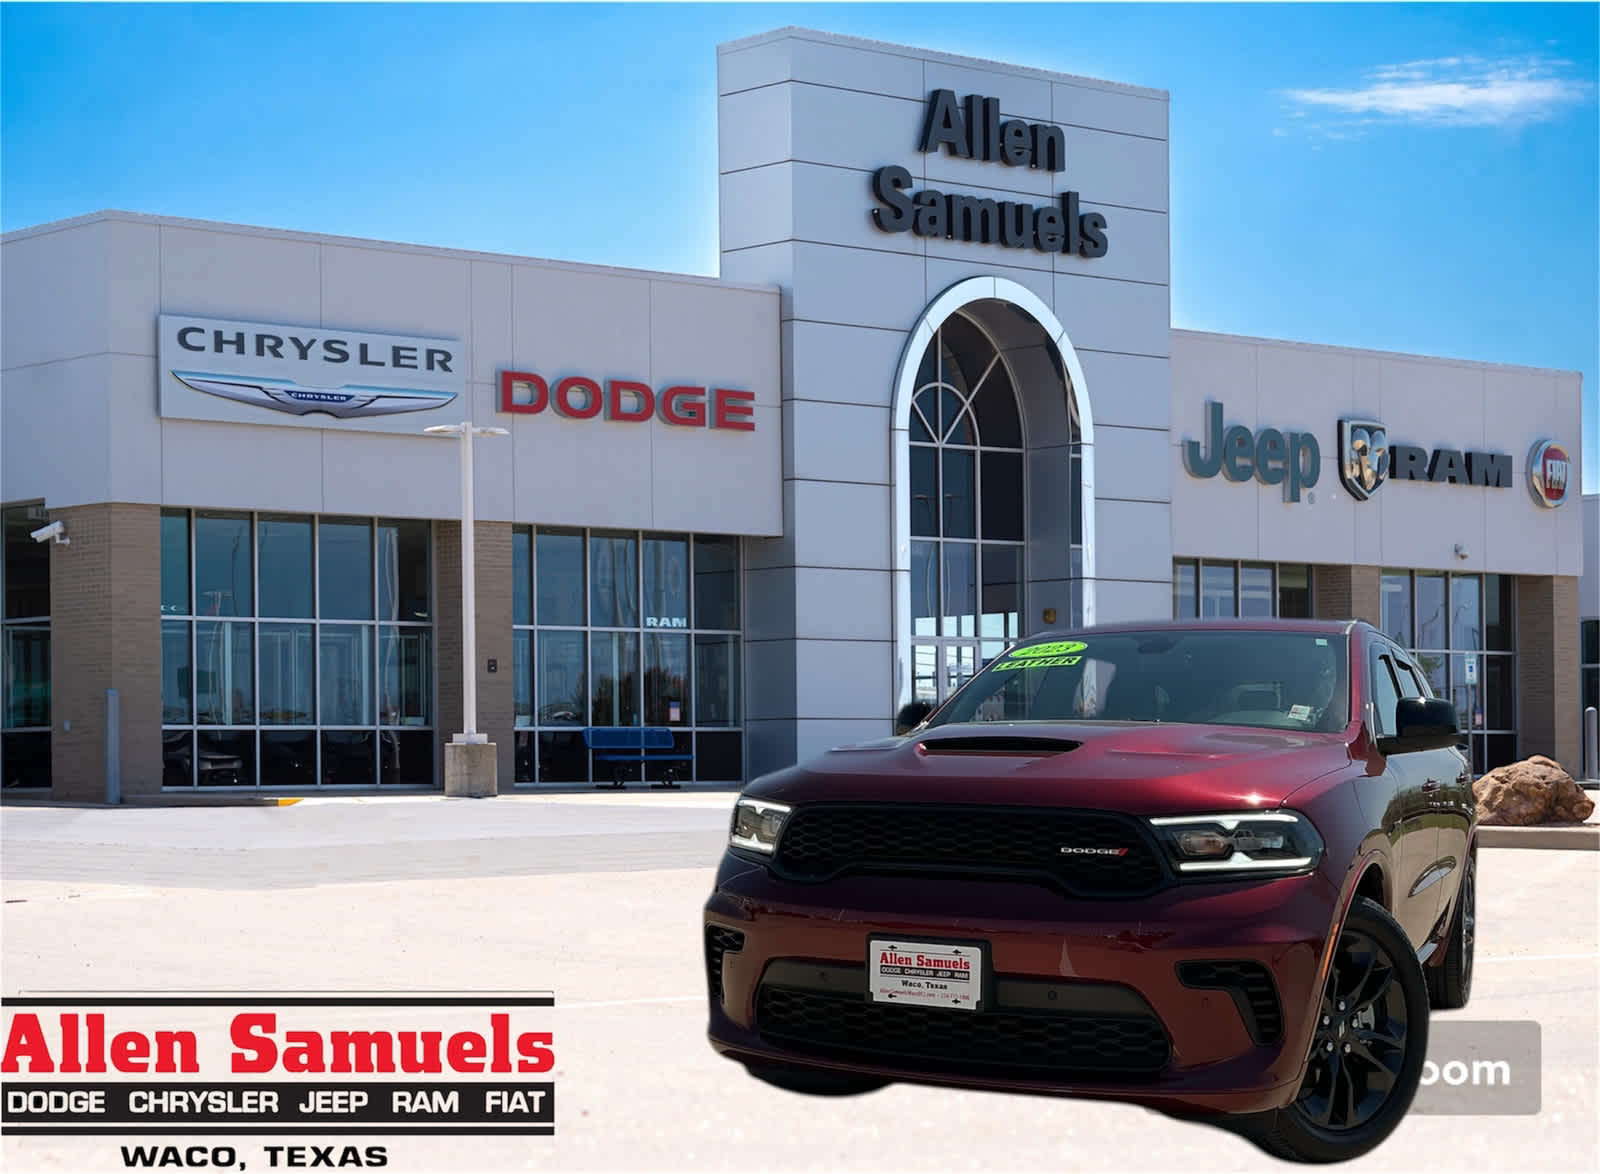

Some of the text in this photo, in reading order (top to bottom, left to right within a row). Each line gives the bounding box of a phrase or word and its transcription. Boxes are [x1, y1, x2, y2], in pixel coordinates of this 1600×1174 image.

[919, 88, 1066, 173] Allen
[872, 165, 1109, 258] Samuels
[177, 326, 454, 373] CHRYSLER
[496, 370, 756, 432] DODGE
[1183, 400, 1321, 503] Jeep
[1389, 445, 1513, 488] RAM
[1545, 459, 1568, 490] FIAT
[646, 616, 687, 628] RAM
[1060, 847, 1120, 855] DODGE
[880, 951, 970, 970] Allen Samuels
[925, 981, 948, 990] Texas
